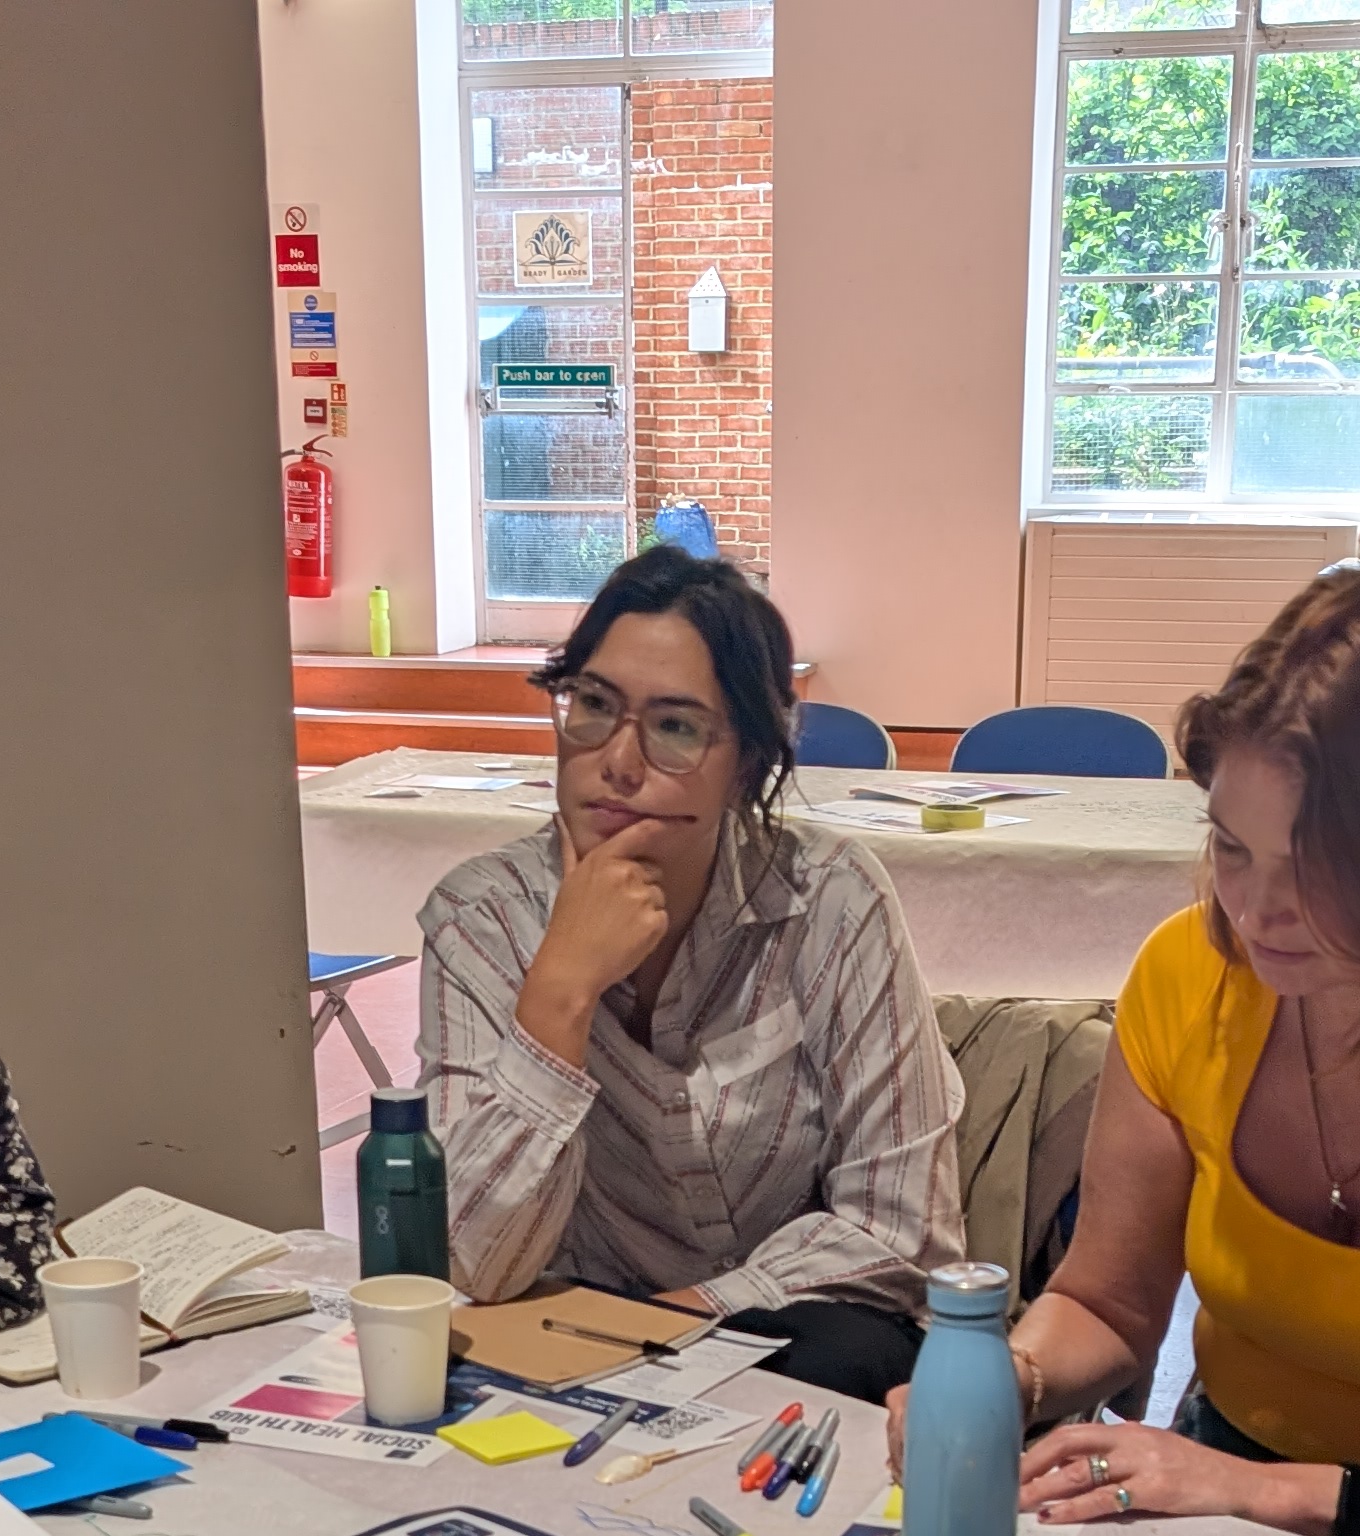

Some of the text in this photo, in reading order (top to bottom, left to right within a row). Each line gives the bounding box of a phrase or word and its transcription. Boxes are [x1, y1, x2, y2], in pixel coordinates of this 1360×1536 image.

[289, 248, 304, 259] No
[278, 261, 319, 273] smoking
[523, 269, 589, 277] BRADY GARDEN
[502, 369, 607, 383] Push bar to open
[209, 1408, 432, 1451] SOCIAL HEALTH HUB
